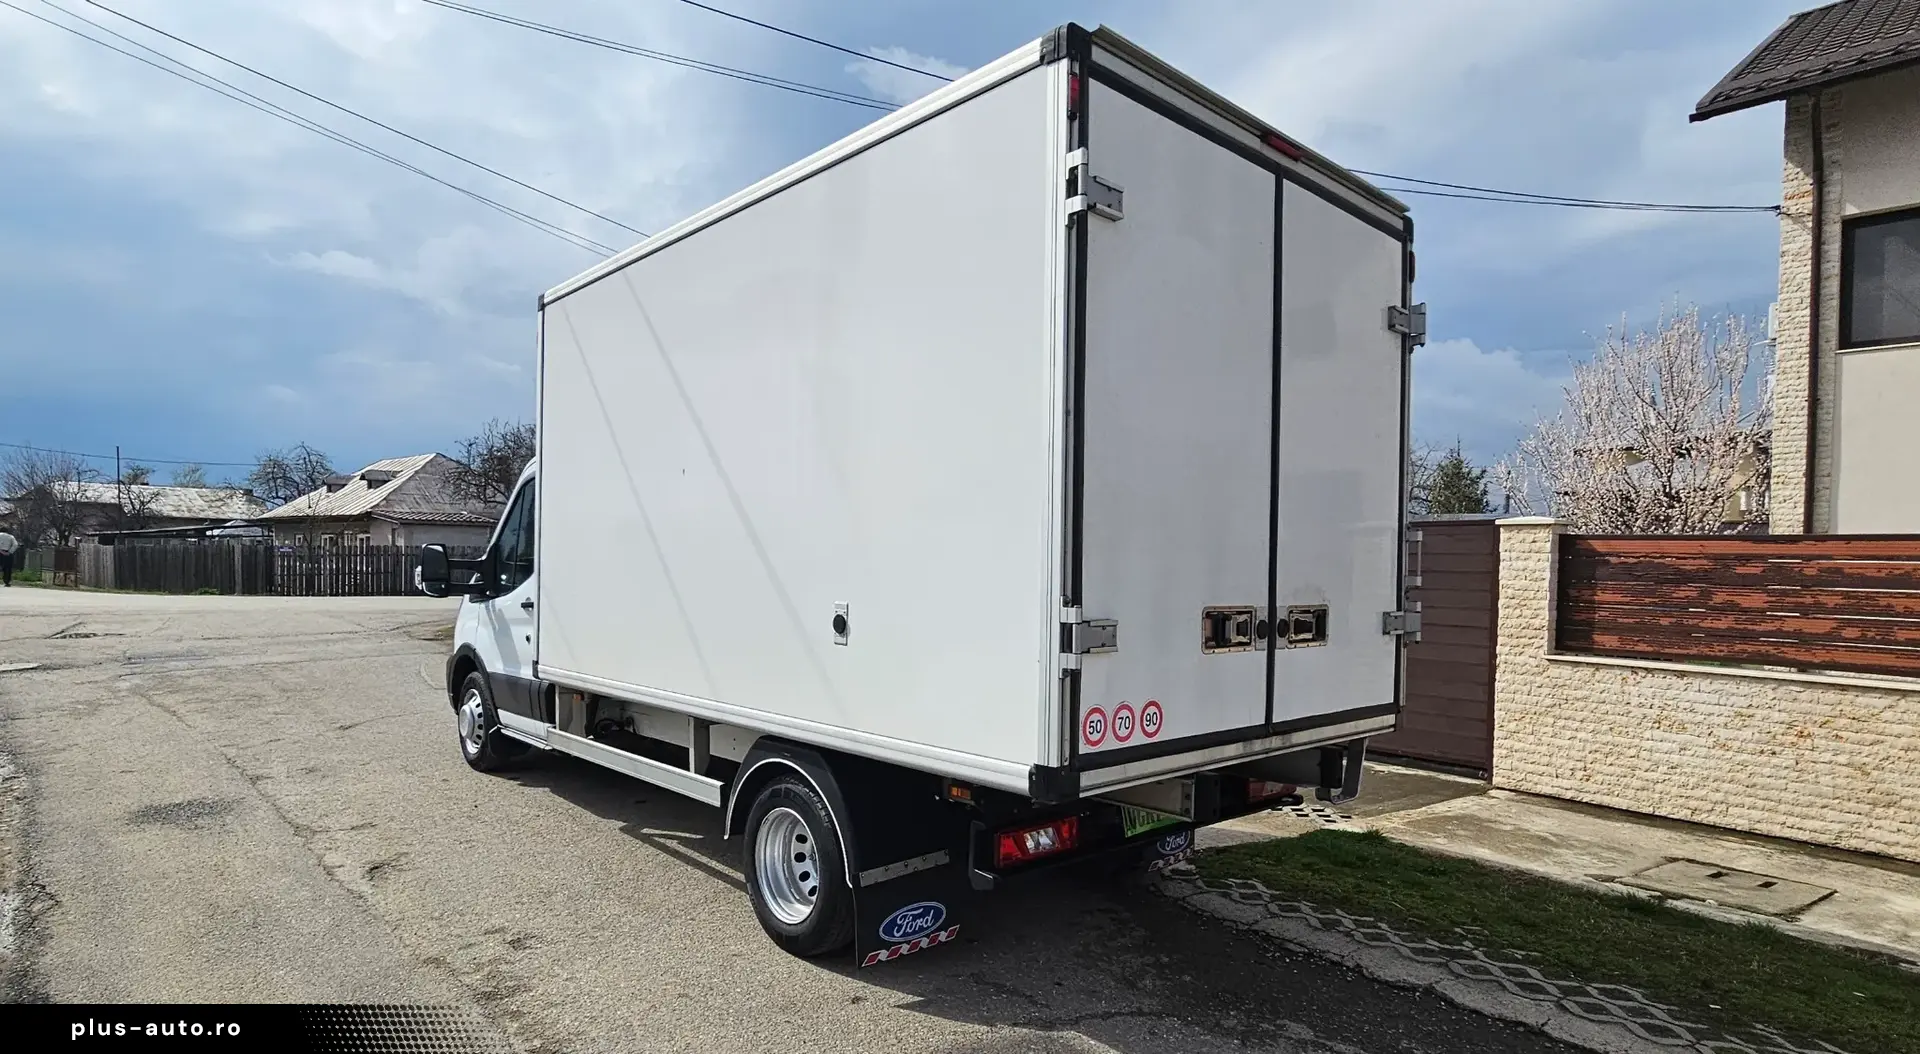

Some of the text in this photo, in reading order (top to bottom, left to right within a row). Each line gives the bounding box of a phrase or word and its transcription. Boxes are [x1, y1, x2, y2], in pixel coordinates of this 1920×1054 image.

[1088, 719, 1103, 735] 50
[1117, 715, 1131, 731] 70
[1145, 711, 1159, 727] 90
[1164, 832, 1186, 851] Ford
[893, 908, 935, 937] Ford
